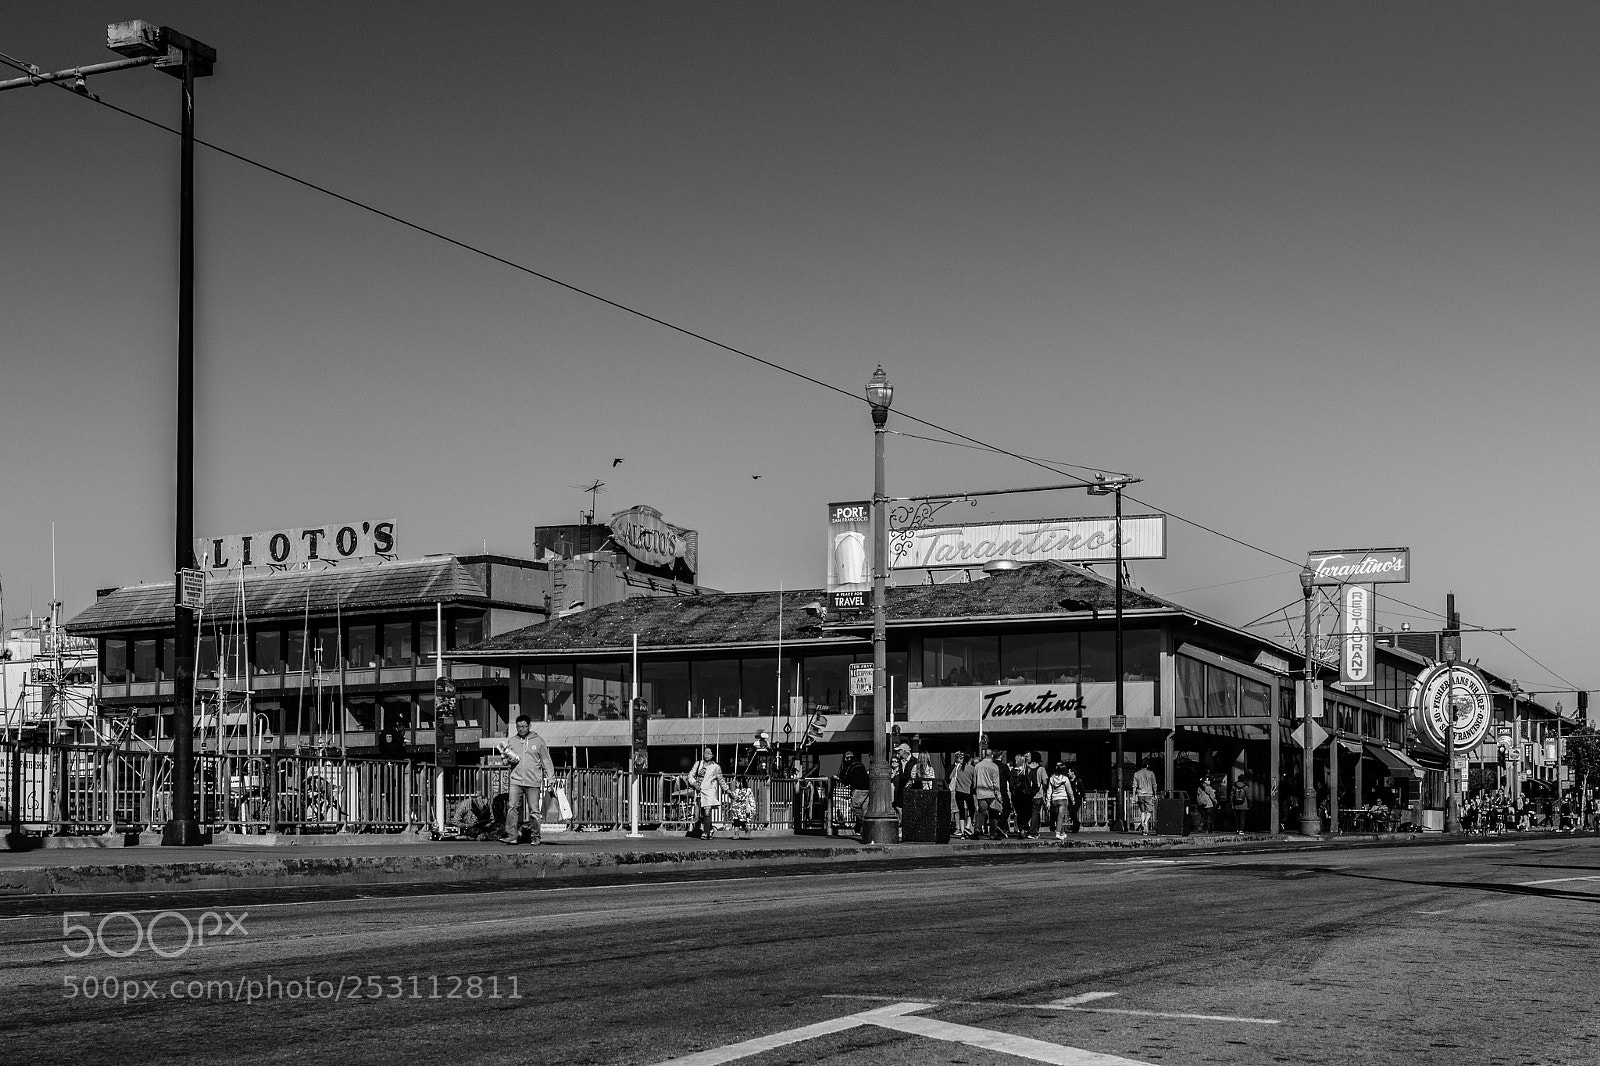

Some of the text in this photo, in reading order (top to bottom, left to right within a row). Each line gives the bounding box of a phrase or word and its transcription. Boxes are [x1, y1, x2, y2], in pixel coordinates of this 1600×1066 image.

[836, 506, 864, 518] PORT
[193, 521, 394, 569] LIOTO'S
[916, 522, 1132, 567] Tarantino's
[1310, 554, 1405, 579] Tarantino's
[834, 596, 864, 607] TRAVEL
[1351, 591, 1363, 676] RESTAURANT
